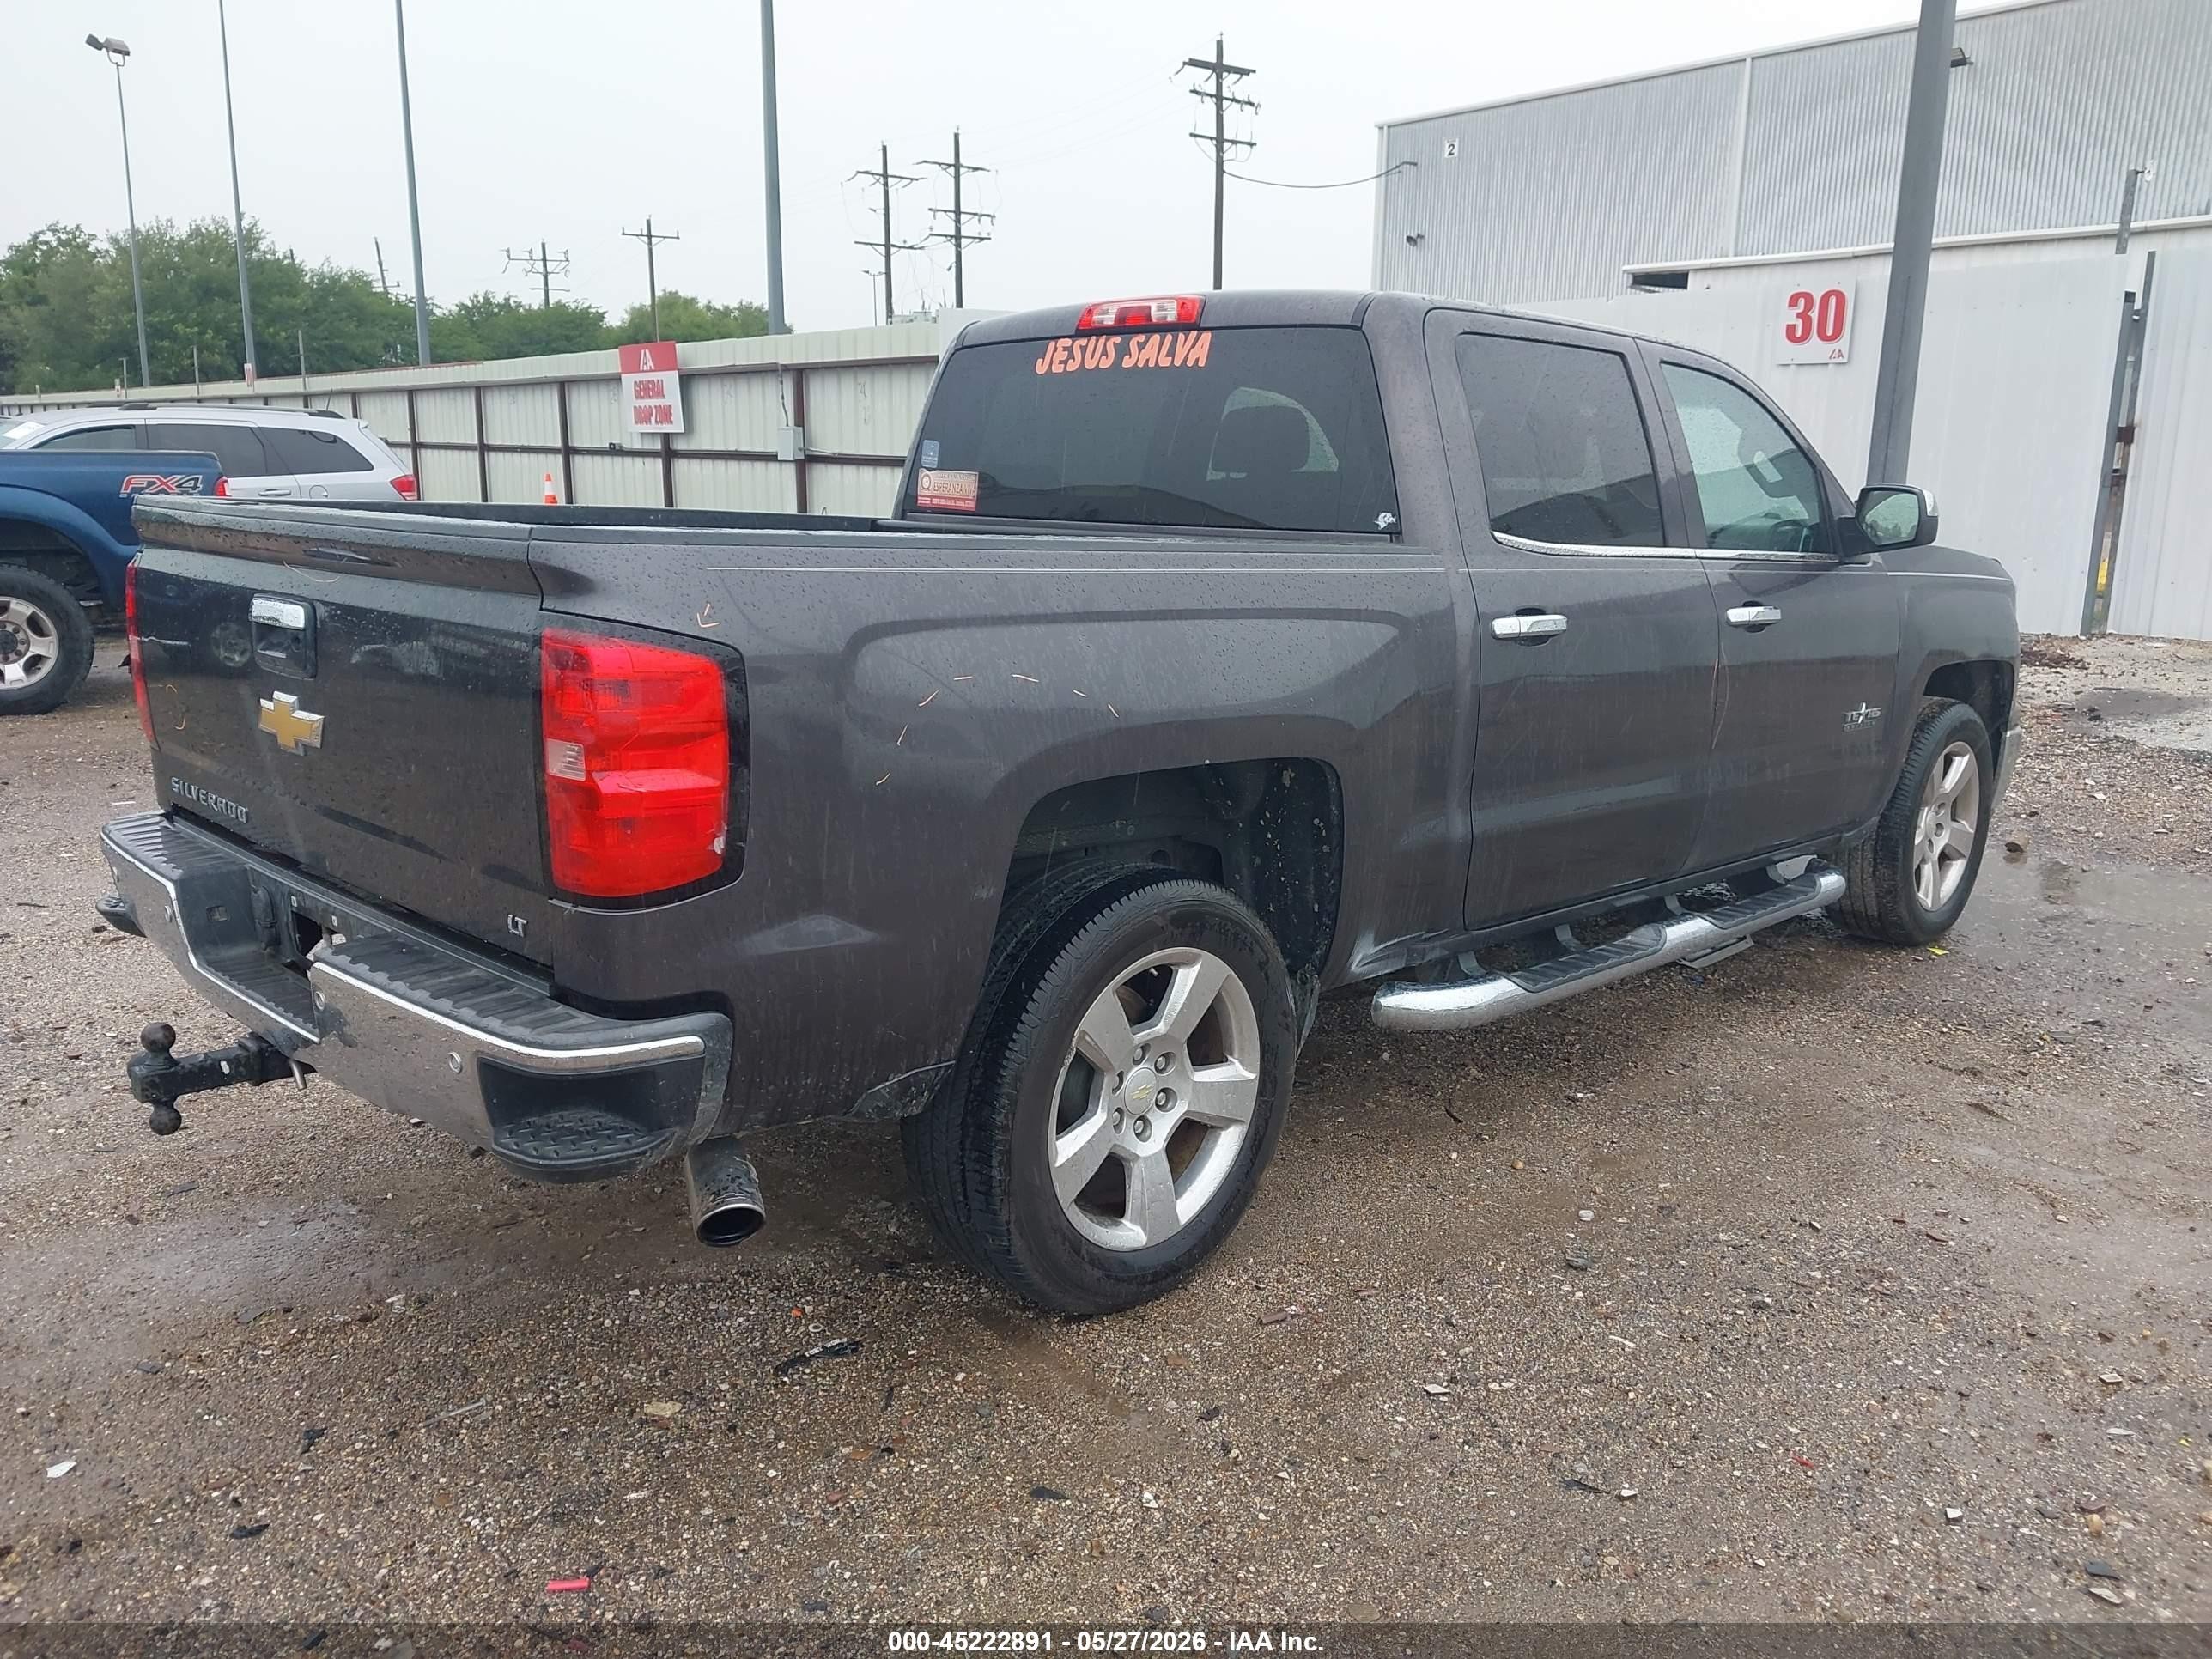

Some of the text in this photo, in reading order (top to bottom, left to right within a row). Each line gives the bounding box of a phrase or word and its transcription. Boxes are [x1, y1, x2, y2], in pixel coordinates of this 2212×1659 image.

[1447, 143, 1455, 156] 2
[1785, 289, 1846, 344] 30
[1035, 330, 1212, 375] JESUS SALVA
[633, 379, 666, 400] GENERAL
[633, 404, 674, 426] DROP ZONE
[120, 475, 204, 494] FX4
[171, 776, 247, 824] SILVERADO
[507, 914, 527, 938] LT
